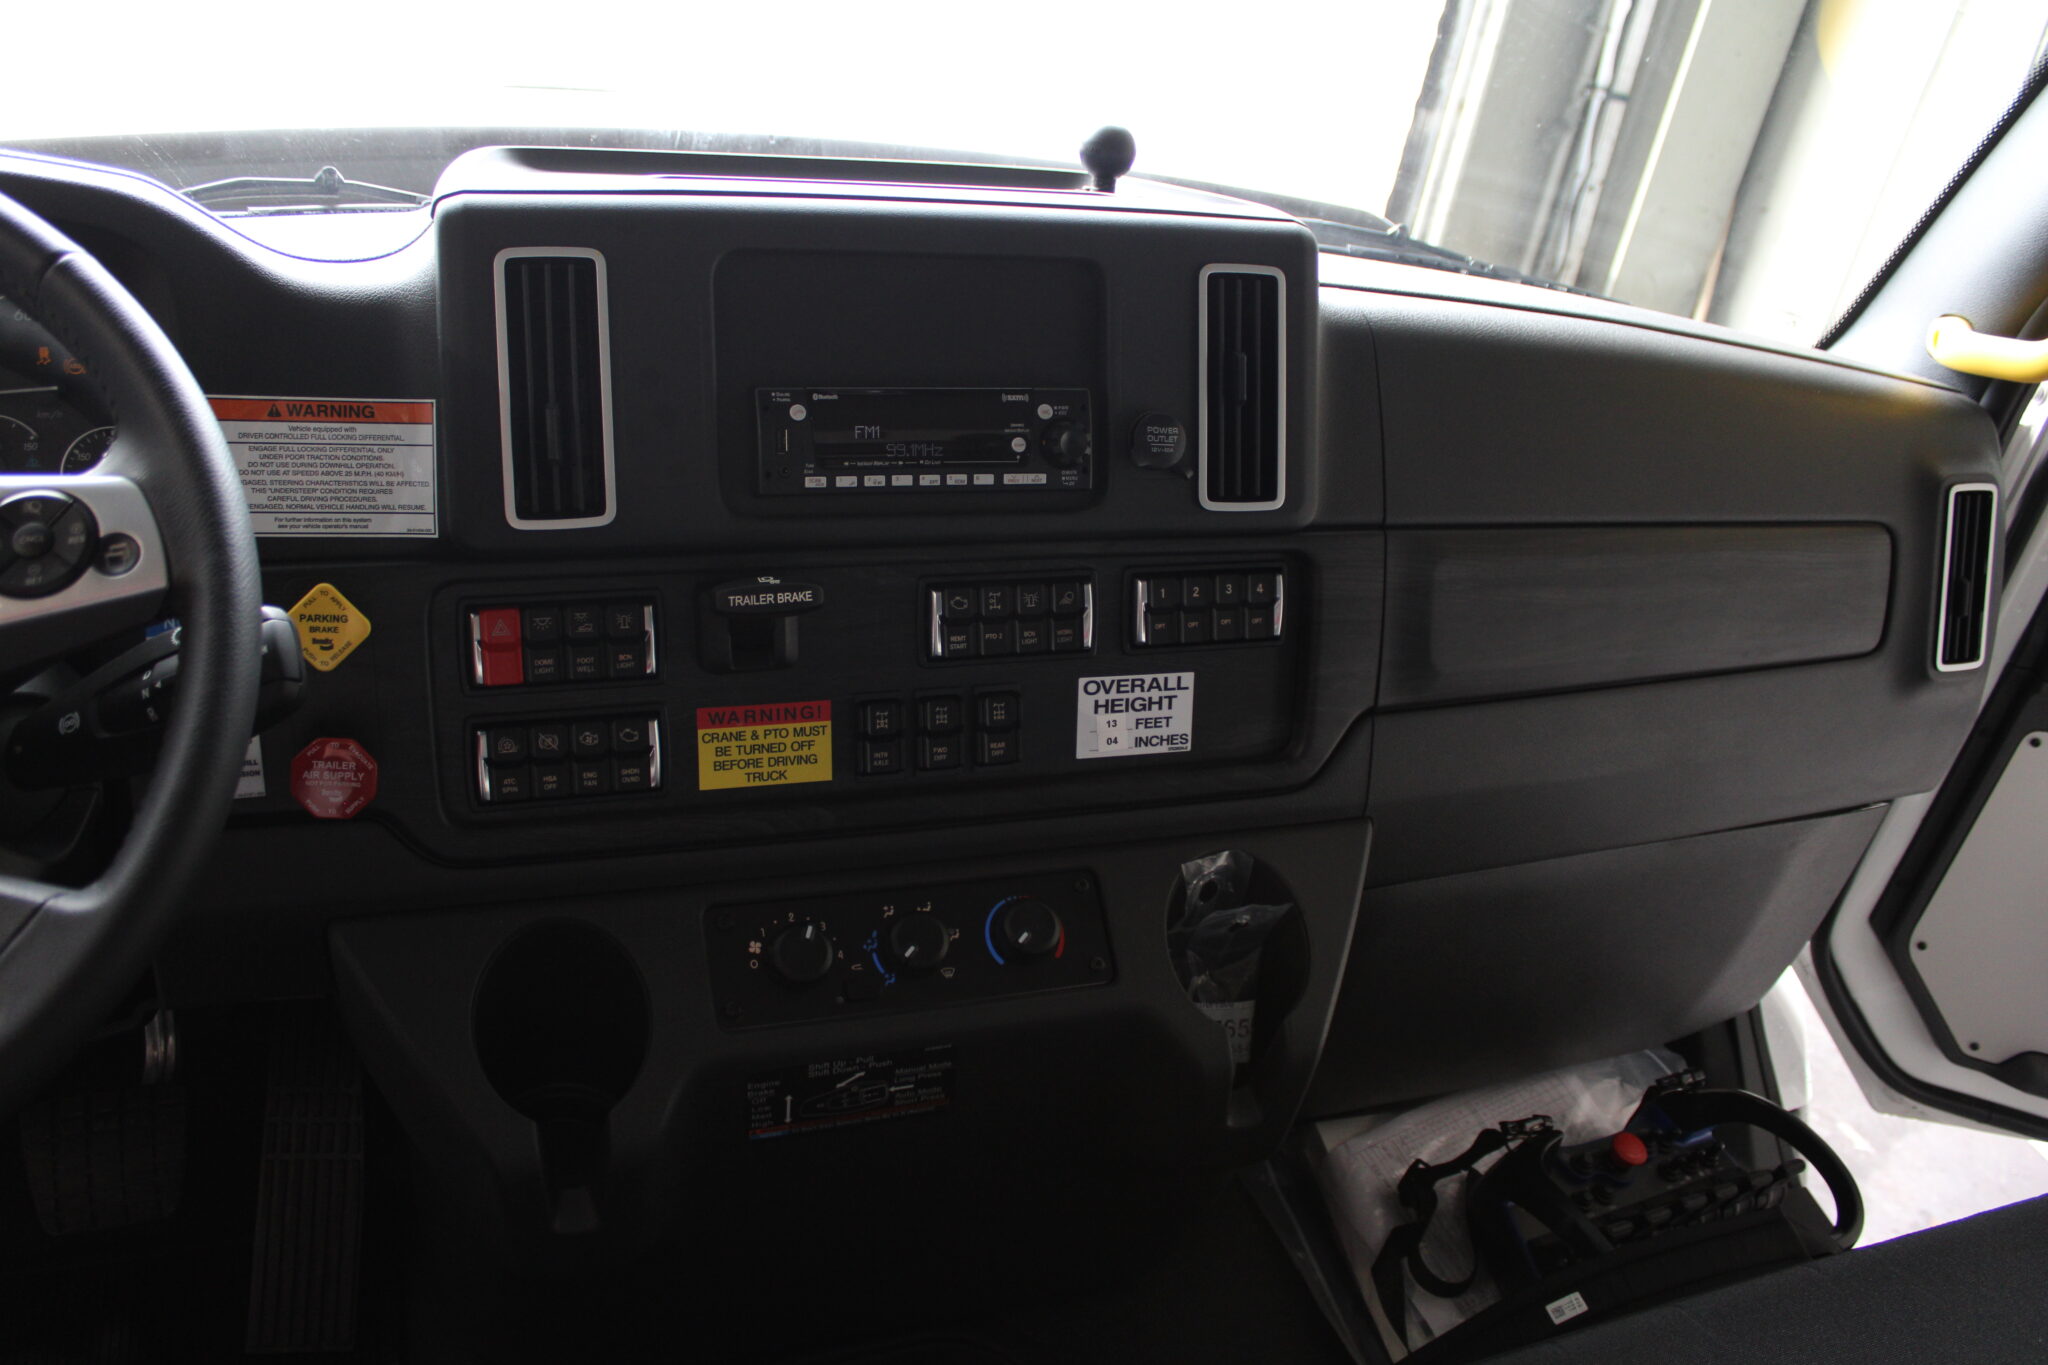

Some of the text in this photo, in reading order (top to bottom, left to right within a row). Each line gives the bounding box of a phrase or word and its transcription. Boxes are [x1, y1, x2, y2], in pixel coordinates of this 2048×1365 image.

[286, 404, 375, 418] WARNING
[854, 425, 880, 440] FM1
[1146, 426, 1178, 434] POWER
[1146, 434, 1178, 443] OUTLET
[886, 442, 944, 457] 99.1MHz
[1160, 588, 1165, 599] 1
[1192, 586, 1200, 598] 2
[1225, 584, 1232, 594] 3
[1256, 583, 1264, 594] 4
[728, 590, 813, 607] TRAILER BRAKE
[299, 614, 348, 623] PARKING
[576, 665, 595, 673] WELL
[1083, 676, 1189, 696] OVERALL
[1094, 695, 1178, 714] HEIGHT
[708, 705, 822, 725] WARNING!
[1106, 716, 1172, 730] 13 FEET
[701, 725, 828, 744] CRANE & PTO MUST
[1107, 737, 1118, 745] 04
[1135, 733, 1189, 748] INCHES
[715, 740, 815, 757] BE TURNED OFF
[312, 760, 356, 770] TRAILER
[713, 754, 818, 771] BEFORE DRIVING
[303, 771, 364, 781] AIR SUPPLY
[744, 770, 788, 783] TRUCK
[789, 912, 794, 922] 2
[819, 921, 826, 931] 3
[760, 927, 765, 938] 1
